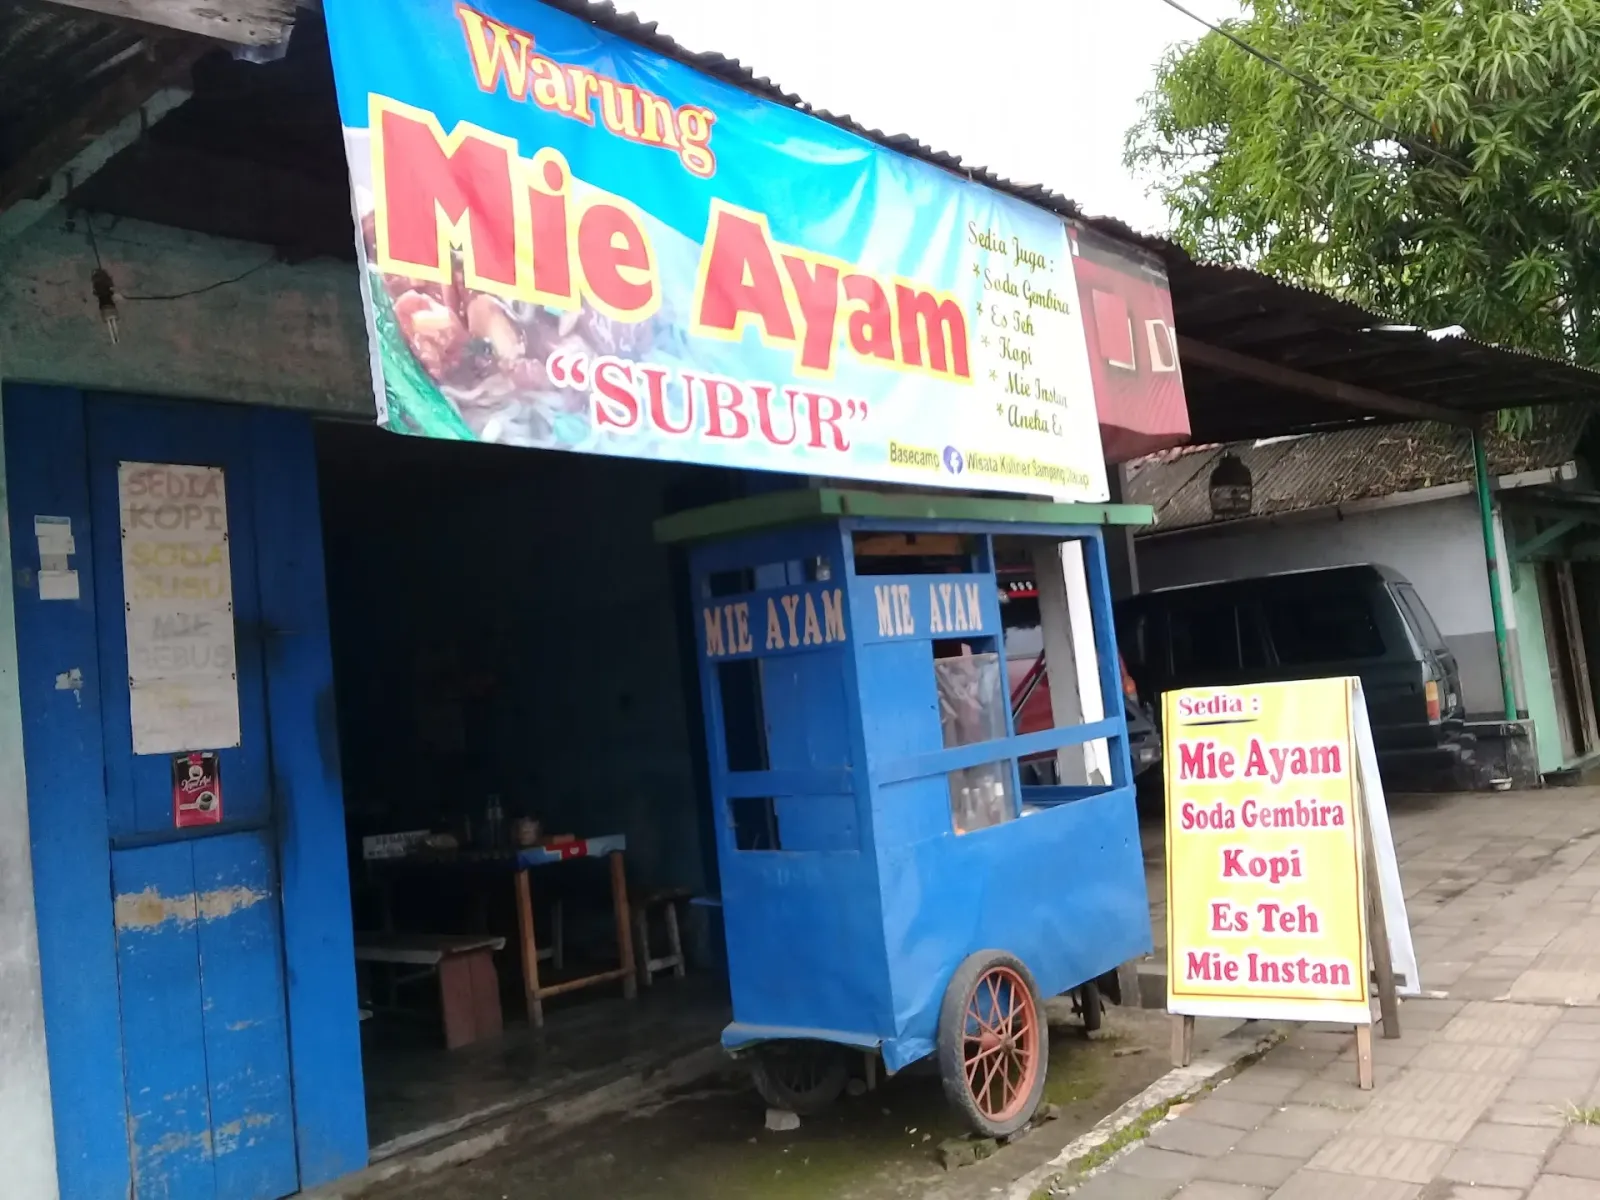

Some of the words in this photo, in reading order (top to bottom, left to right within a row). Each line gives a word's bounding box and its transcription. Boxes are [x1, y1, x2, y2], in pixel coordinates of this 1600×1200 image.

[458, 4, 716, 177] Warung
[377, 104, 657, 317] Mie
[696, 205, 970, 381] Ayam
[968, 221, 1007, 256] Sedia
[1012, 237, 1046, 273] Juga
[984, 268, 1019, 298] Soda
[1022, 279, 1070, 315] Gembira
[991, 304, 1008, 328] Es
[1014, 310, 1035, 336] Teh
[999, 336, 1032, 369] Kopi
[1005, 371, 1031, 397] Mie
[1008, 404, 1049, 433] Aneka
[890, 441, 940, 470] Basecamp
[966, 452, 998, 472] Wisata
[127, 468, 221, 499] SEDIA
[129, 502, 223, 531] KOPI
[703, 602, 753, 657] MIE
[765, 588, 846, 650] AYAM
[874, 584, 914, 637] MIE
[929, 582, 983, 632] AYAM
[1179, 695, 1243, 716] Sedia
[1179, 742, 1235, 780] Mie
[1244, 738, 1341, 784] Ayam
[1182, 802, 1235, 830] Soda
[1241, 799, 1344, 828] Gembira
[1222, 849, 1302, 884] Kopi
[1211, 903, 1249, 932] Es
[1257, 903, 1319, 933] Teh
[1187, 952, 1239, 981] Mie
[1247, 953, 1350, 985] Instan
